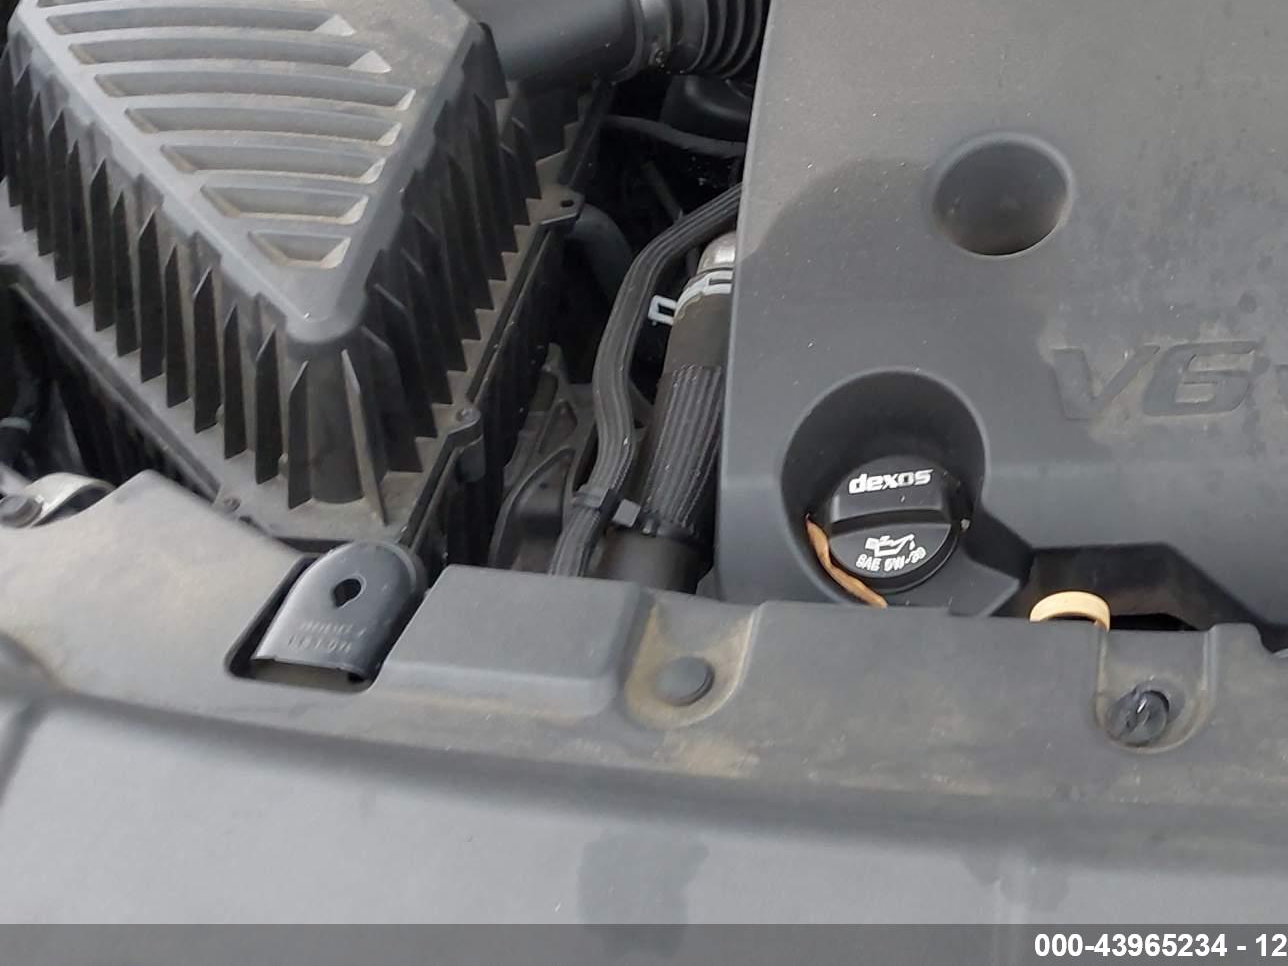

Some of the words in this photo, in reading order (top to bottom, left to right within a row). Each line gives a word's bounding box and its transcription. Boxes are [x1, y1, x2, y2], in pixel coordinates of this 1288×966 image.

[1050, 339, 1262, 421] V6
[848, 469, 934, 494] dexos
[855, 553, 882, 572] SAE
